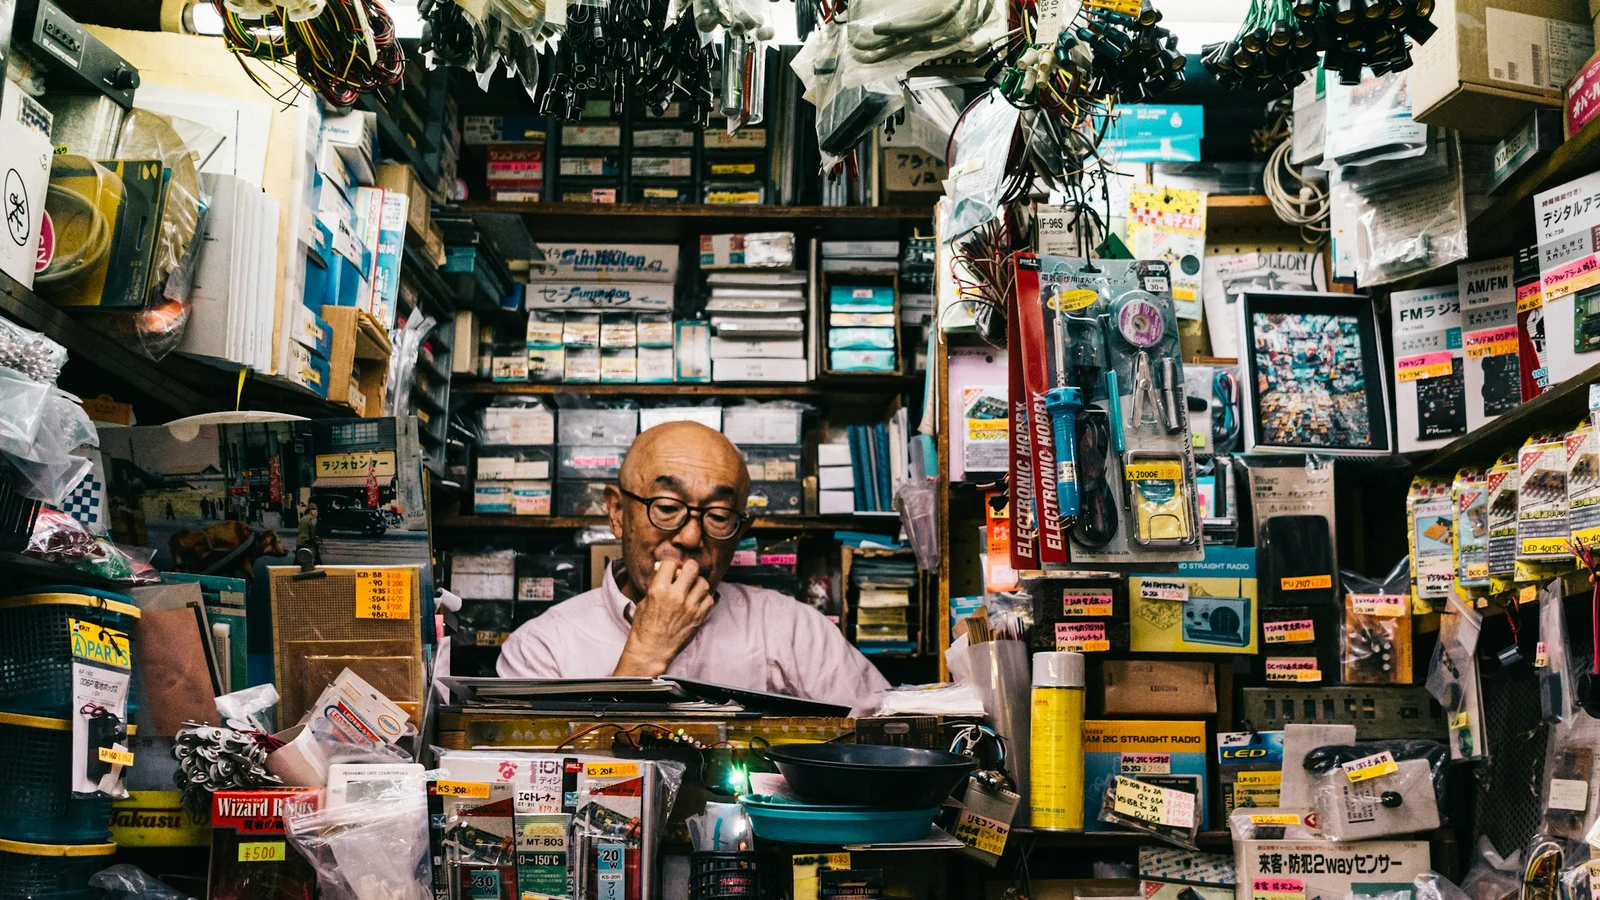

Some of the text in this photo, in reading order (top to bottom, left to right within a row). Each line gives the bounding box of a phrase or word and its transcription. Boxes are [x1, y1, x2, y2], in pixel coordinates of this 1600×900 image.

[1039, 218, 1063, 229] IF-96S
[1466, 275, 1508, 296] AM/FM
[1033, 391, 1051, 447] HOBBY
[1039, 451, 1062, 550] ELECTRONIC
[1016, 460, 1033, 558] ELECTRONIC
[1171, 736, 1201, 744] RADIO
[1223, 749, 1267, 758] LED
[518, 792, 556, 801] ICトレーナー
[218, 798, 268, 817] Wizard
[968, 814, 995, 829] リモコン
[526, 838, 564, 846] MT-803
[244, 846, 275, 861] ¥500
[602, 849, 619, 861] 20
[476, 876, 494, 887] 30
